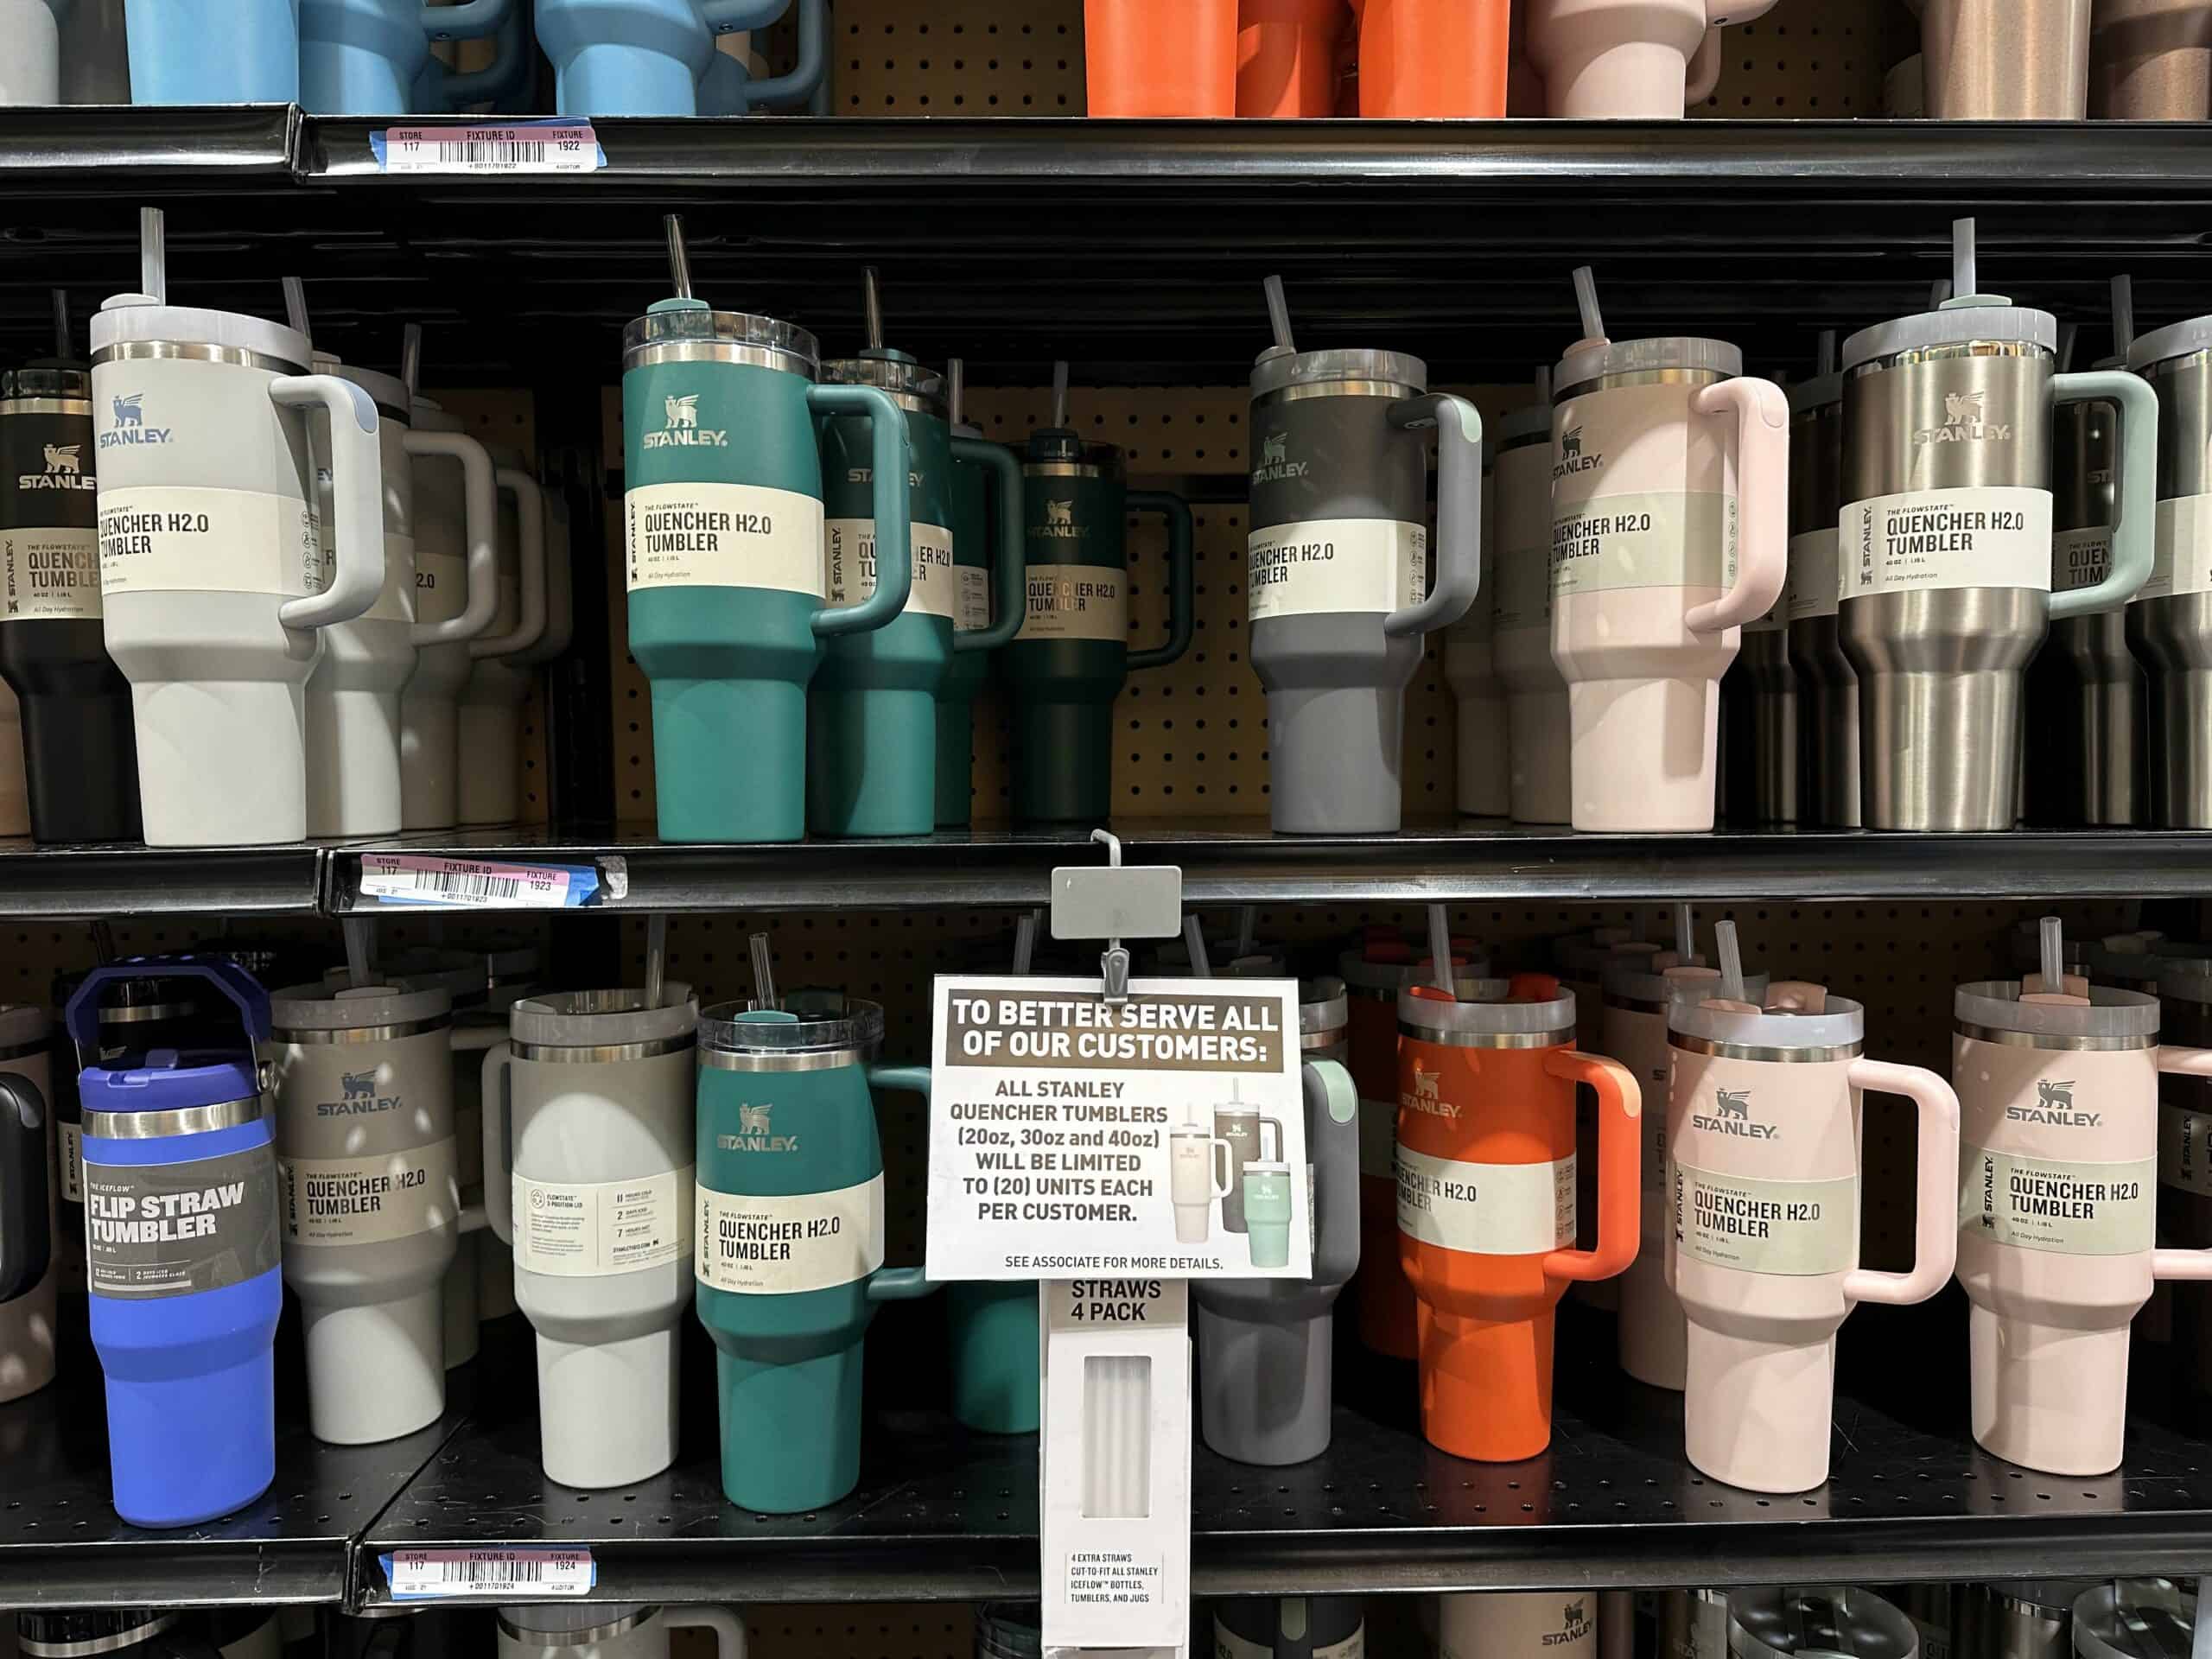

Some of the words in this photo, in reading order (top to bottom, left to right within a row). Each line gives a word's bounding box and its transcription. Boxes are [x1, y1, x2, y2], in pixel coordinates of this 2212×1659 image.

[399, 131, 423, 140] STORE
[467, 130, 503, 141] FIXTURE
[506, 130, 515, 140] ID
[552, 130, 583, 139] FIXTURE
[404, 143, 419, 152] 117
[558, 141, 581, 151] 1922
[100, 429, 171, 448] STANLEY
[644, 430, 727, 449] STANLEY
[1913, 424, 2010, 445] STANLEY
[19, 475, 97, 491] STANLE
[168, 513, 209, 532] H2.0
[645, 512, 731, 533] QUENCHER
[735, 514, 772, 535] H2.0
[1028, 525, 1090, 538] STANLEY
[1615, 513, 1651, 534] H2.0
[1887, 512, 1986, 536] QUENCHER
[1991, 511, 2024, 531] H2.0
[645, 533, 719, 553] TUMBLER
[1862, 506, 1872, 567] STANLEY
[1886, 532, 1974, 556] TUMBLER
[29, 552, 98, 569] QUENCH
[832, 527, 842, 585] STANLEY
[1301, 543, 1334, 562] H2.0
[29, 571, 99, 588] TUMBLE
[416, 573, 435, 589] 2.0
[1096, 584, 1116, 599] H2.0
[376, 857, 401, 866] STORE
[381, 865, 397, 875] 117
[443, 861, 480, 874] FIXTURE
[484, 866, 493, 874] ID
[526, 870, 557, 880] FIXTURE
[530, 880, 552, 892] 1923
[952, 998, 993, 1026] TO
[998, 1000, 1113, 1028] BETTER
[1120, 1002, 1215, 1031] SERVE
[1221, 1005, 1279, 1033] ALL
[963, 1030, 1004, 1057] OF
[1009, 1031, 1071, 1058] OUR
[1077, 1033, 1268, 1063] CUSTOMERS:
[995, 1079, 1033, 1098] ALL
[1037, 1080, 1124, 1099] STANLEY
[317, 1096, 401, 1116] STANLEY
[950, 1103, 1057, 1122] QUENCHER
[1062, 1105, 1168, 1123] TUMBLERS
[1402, 1093, 1461, 1118] STANLEY
[2006, 1106, 2101, 1127] STANLEY
[1693, 1115, 1777, 1140] STANLEY
[717, 1135, 798, 1152] STANLEY
[957, 1128, 1016, 1148] (20oz,
[1020, 1129, 1065, 1147] 30oz
[1068, 1129, 1103, 1147] and
[1109, 1130, 1160, 1149] 40oz)
[976, 1153, 1026, 1171] WILL
[1031, 1154, 1057, 1171] BE
[1061, 1154, 1141, 1172] LIMITED
[307, 1176, 390, 1198] QUENCHER
[396, 1169, 426, 1191] H2.0
[963, 1178, 988, 1195] TO
[993, 1177, 1031, 1198] (20)
[1036, 1179, 1096, 1197] UNITS
[1101, 1179, 1154, 1198] EACH
[1445, 1181, 1477, 1202] H2.0
[1984, 1156, 1993, 1212] STANLEY
[2010, 1176, 2106, 1201] QUENCHER
[2110, 1182, 2139, 1201] H2.0
[90, 1193, 136, 1219] FLIP
[140, 1181, 245, 1219] STRAW
[307, 1195, 381, 1216] TUMBLER
[1694, 1190, 1782, 1220] QUENCHER
[1787, 1203, 1821, 1221] H2.0
[2009, 1193, 2094, 1219] TUMBLER
[617, 1211, 623, 1220] 2
[978, 1204, 1018, 1221] PER
[1022, 1204, 1138, 1222] CUSTOMER.
[91, 1213, 217, 1244] TUMBLER
[618, 1229, 623, 1237] 7
[719, 1219, 803, 1241] QUENCHER
[807, 1217, 841, 1238] H2.0
[1694, 1209, 1770, 1238] TUMBLER
[2033, 1235, 2064, 1243] Hydration
[719, 1239, 791, 1261] TUMBLER
[1005, 1255, 1029, 1268] SEE
[1032, 1255, 1101, 1268] ASSOCIATE
[1103, 1256, 1129, 1268] FOR
[1131, 1256, 1166, 1269] MORE
[1169, 1257, 1224, 1270] DETAILS.
[1071, 1280, 1161, 1299] STRAWS
[1071, 1302, 1085, 1321] 4
[1090, 1302, 1147, 1321] PACK
[410, 1561, 424, 1570] 117
[469, 1552, 503, 1560] FIXTURE
[506, 1552, 516, 1560] ID
[555, 1560, 576, 1571] 1924
[1077, 1554, 1101, 1563] EXTRA
[1103, 1554, 1132, 1563] STRAWS
[1071, 1567, 1110, 1576] CUT-TO-FIT
[1112, 1567, 1125, 1576] ALL
[1127, 1567, 1158, 1576] STANLEY
[1110, 1580, 1144, 1590] BOTTLES,
[1071, 1594, 1112, 1603] TUMBLERS,
[1113, 1594, 1128, 1603] AND
[1130, 1594, 1149, 1603] JUGS
